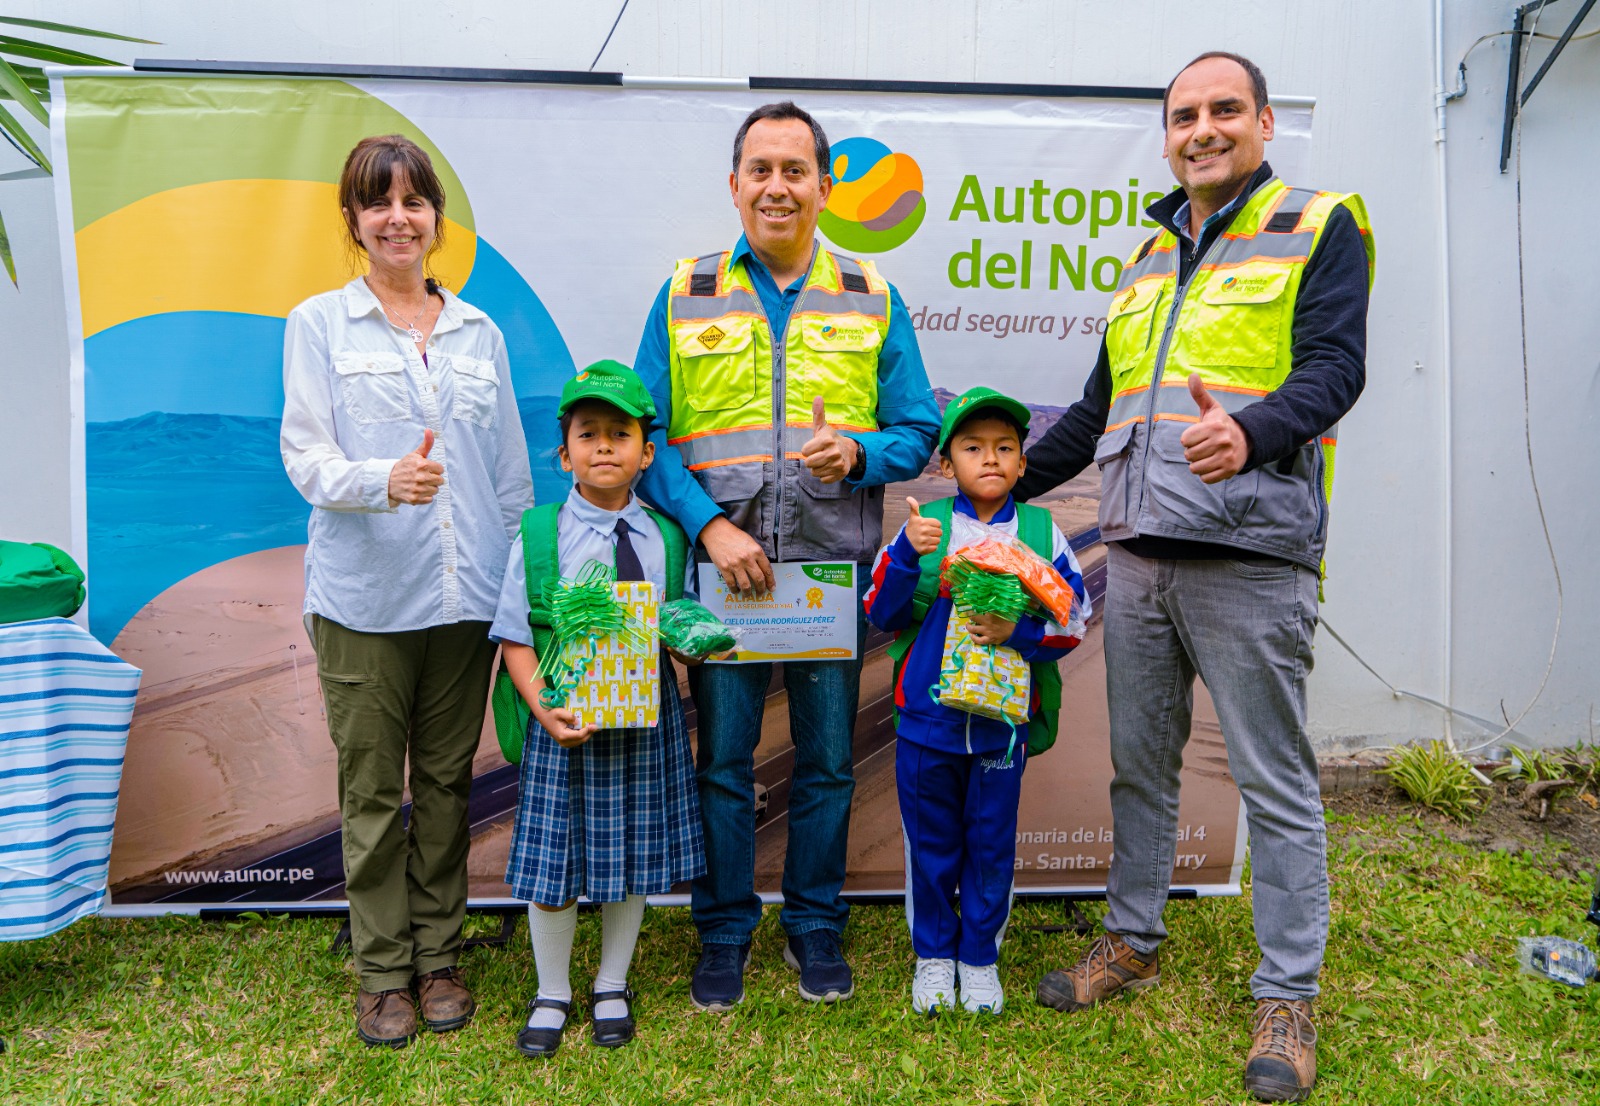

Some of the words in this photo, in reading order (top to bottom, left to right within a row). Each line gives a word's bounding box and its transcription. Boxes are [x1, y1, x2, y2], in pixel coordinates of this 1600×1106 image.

[948, 174, 1182, 239] Autopis
[947, 238, 1033, 290] del
[965, 310, 1055, 339] segura
[1058, 315, 1078, 341] y
[591, 374, 627, 383] Autopista
[603, 381, 624, 389] Norte
[746, 617, 770, 625] LUANA
[771, 615, 813, 625] RODRÍGUEZ
[813, 614, 836, 624] PÉREZ
[1071, 826, 1095, 843] de
[1193, 825, 1207, 841] 4
[165, 867, 315, 884] www.aunor.pe
